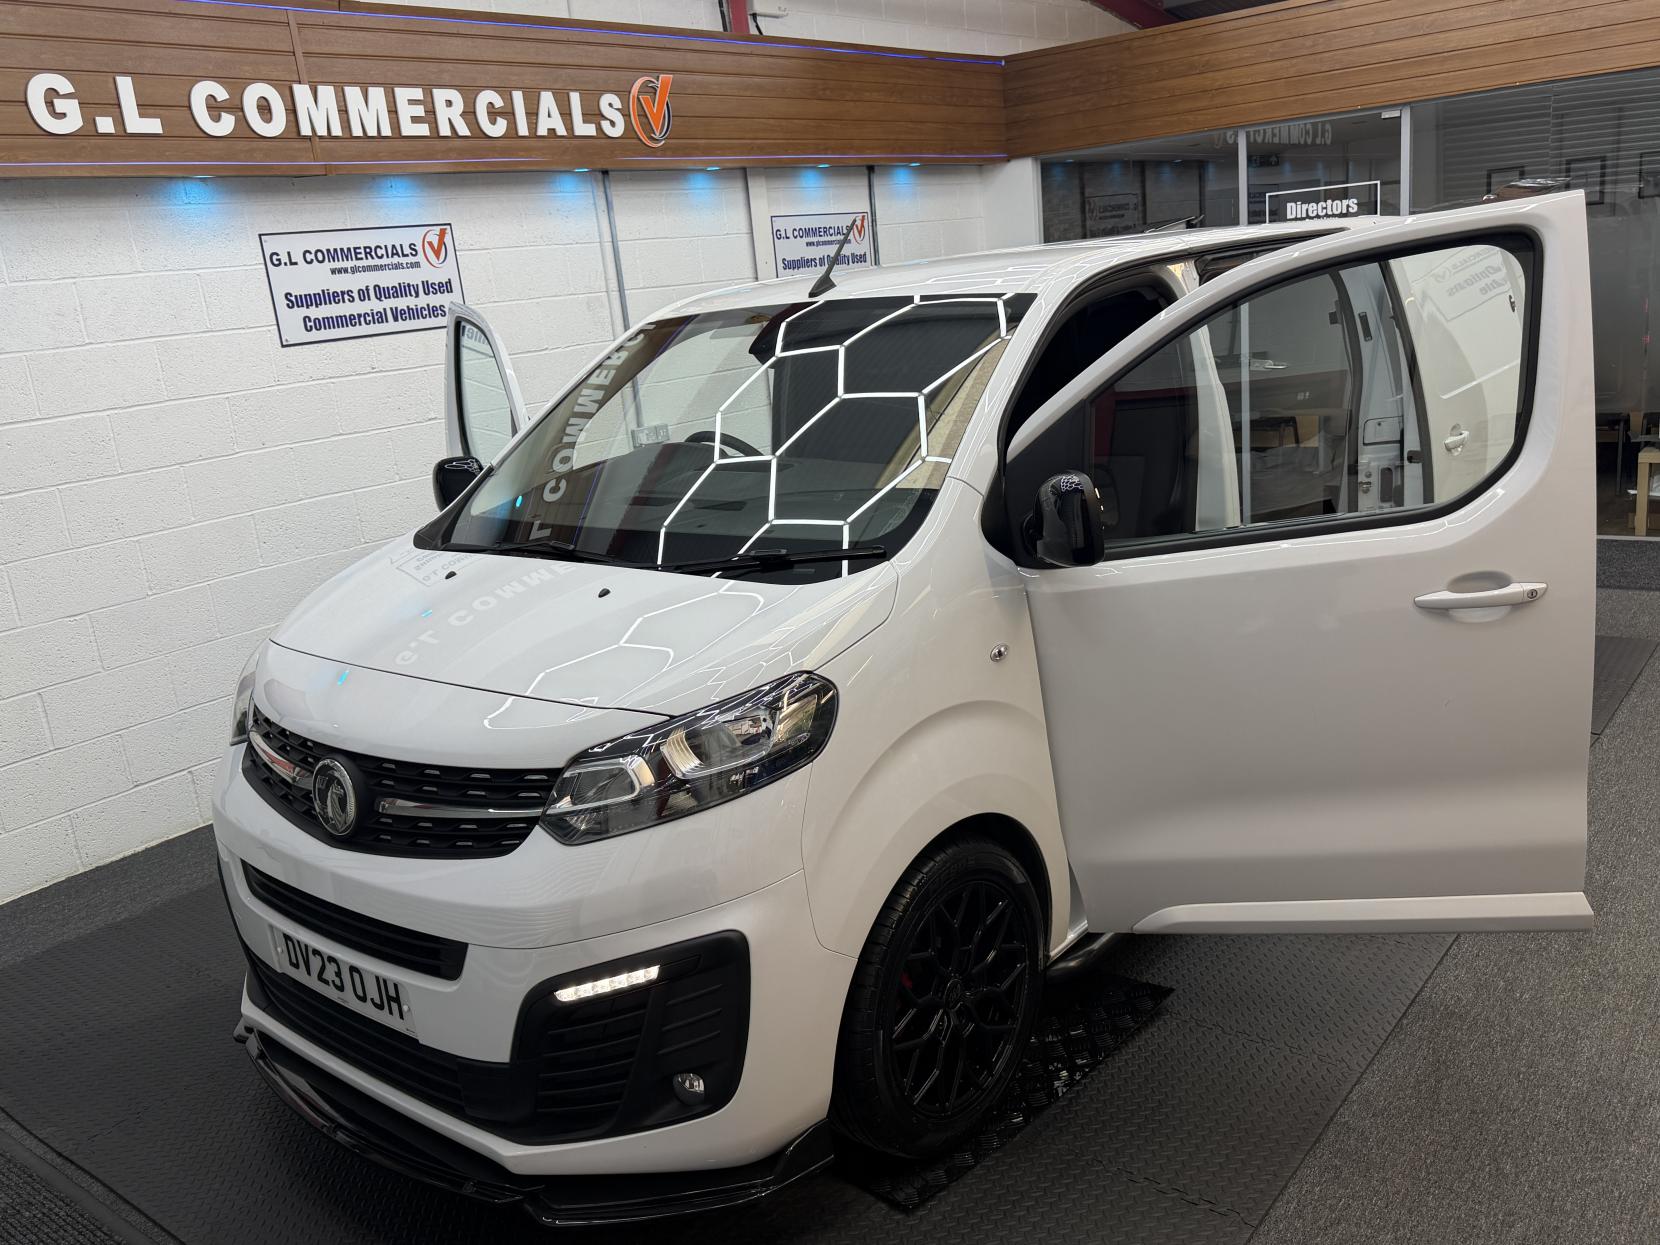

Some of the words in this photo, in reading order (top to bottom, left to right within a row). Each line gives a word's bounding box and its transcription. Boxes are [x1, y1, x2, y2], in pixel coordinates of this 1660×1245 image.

[27, 73, 163, 135] G.L
[190, 80, 626, 137] COMMERCIALS
[1286, 199, 1358, 219] Directors
[775, 227, 790, 240] G.L
[269, 250, 298, 267] G.L
[302, 242, 419, 265] COMMERCIALS
[782, 255, 818, 271] Suppliers
[819, 254, 826, 267] of
[826, 253, 850, 266] Qality
[851, 251, 867, 264] Used
[330, 260, 421, 276] www.glcommercials.com
[284, 287, 355, 309] Suppliers
[357, 284, 372, 302] of
[373, 281, 420, 301] Quality
[421, 278, 453, 296] Used
[302, 308, 389, 332] Commercial
[390, 303, 447, 323] Vehicles
[282, 932, 345, 993] DV23
[349, 966, 405, 1021] OJH
